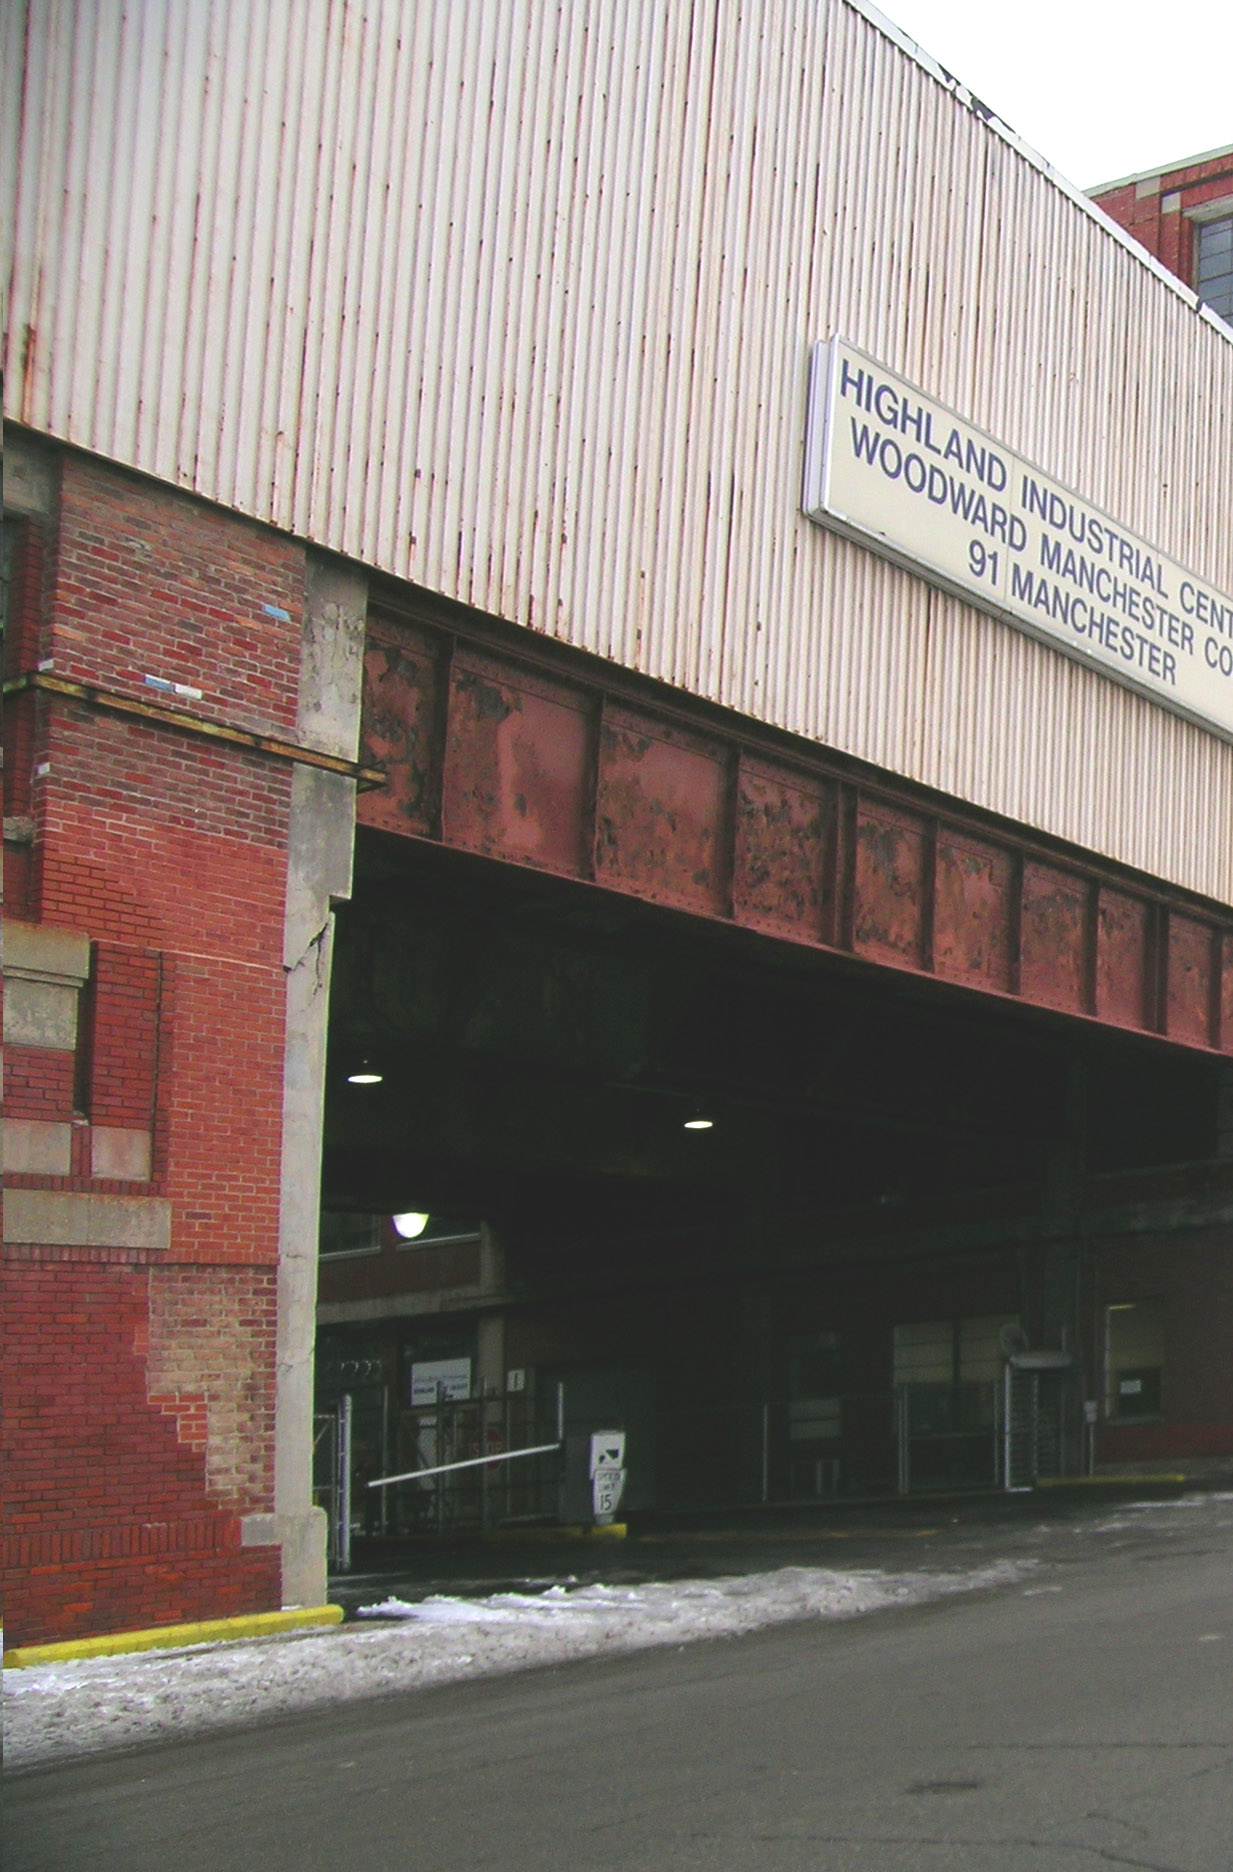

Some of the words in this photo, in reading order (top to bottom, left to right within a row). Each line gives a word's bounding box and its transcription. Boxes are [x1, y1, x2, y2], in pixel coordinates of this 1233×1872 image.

[839, 359, 1007, 492] HIGHLAND
[1021, 474, 1168, 598] INDUSTRIAL
[850, 416, 1027, 552] WOODWARD
[1040, 532, 1194, 655] MANCHESTER
[968, 539, 999, 586] 91
[1011, 563, 1176, 686] MANCHESTER
[472, 1440, 502, 1459] SOP
[600, 1494, 612, 1511] 15
